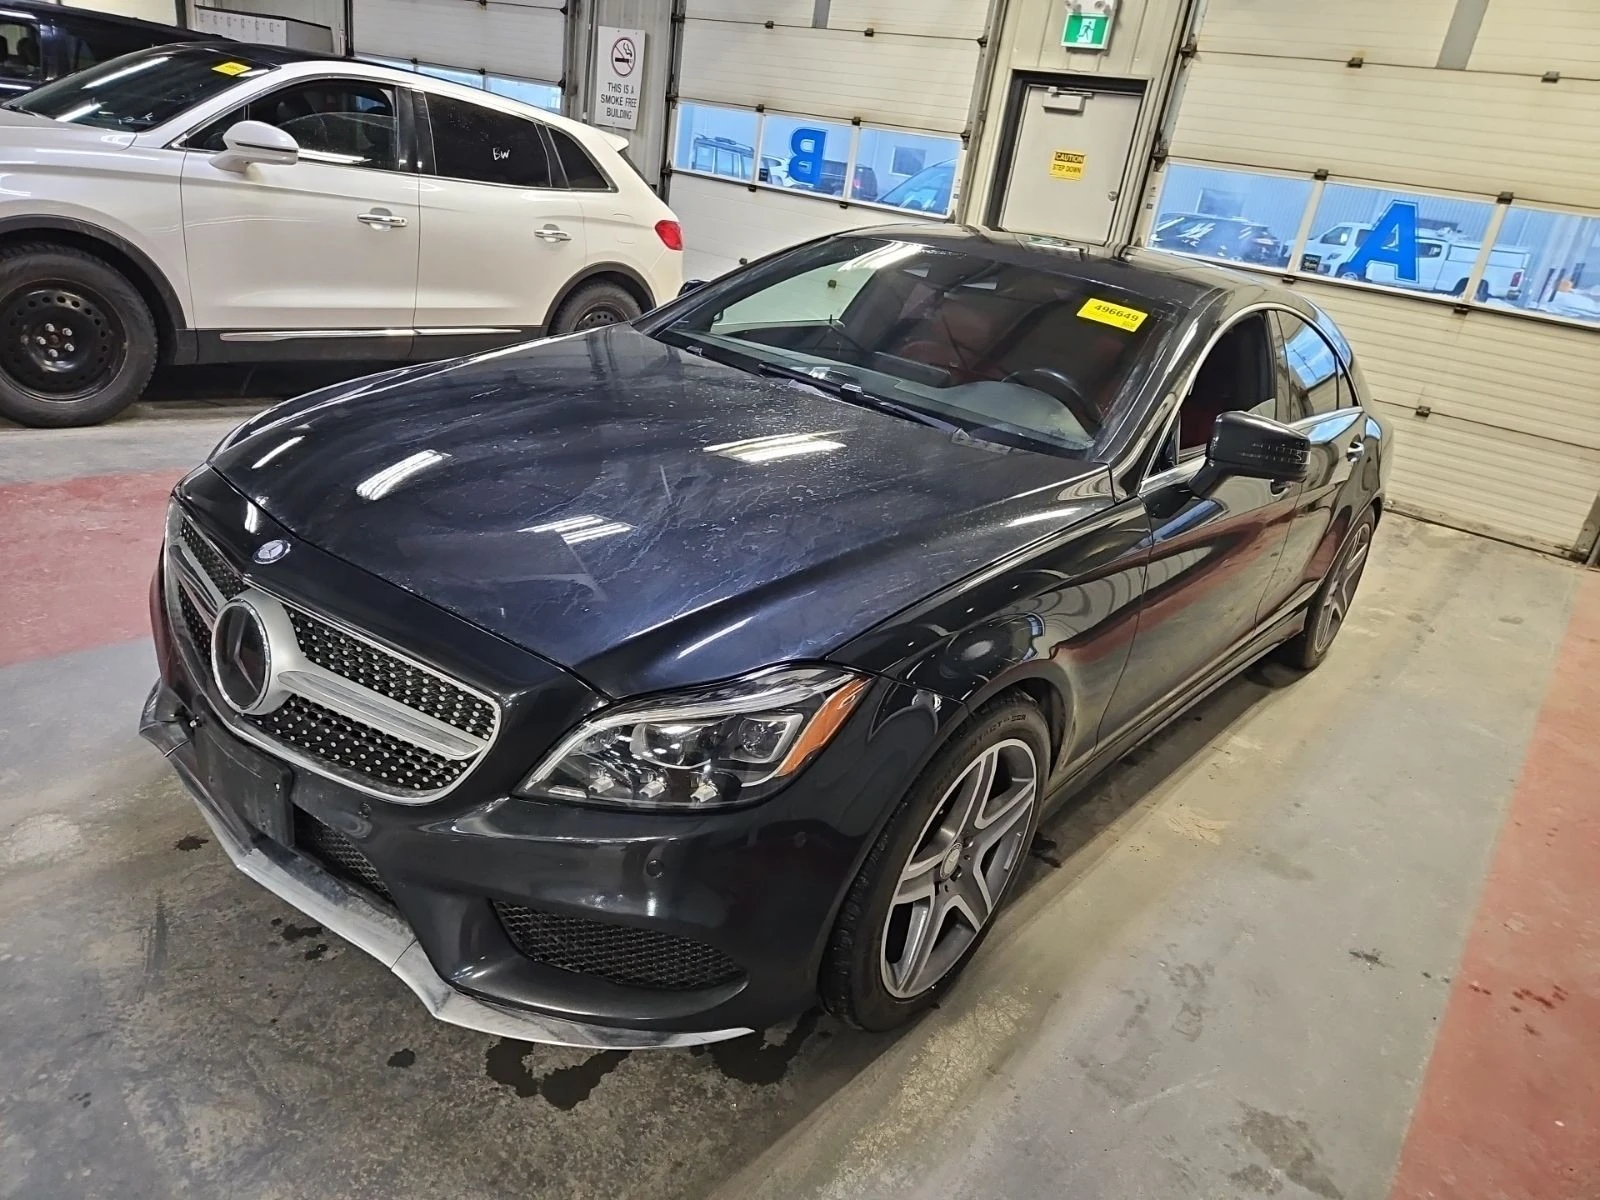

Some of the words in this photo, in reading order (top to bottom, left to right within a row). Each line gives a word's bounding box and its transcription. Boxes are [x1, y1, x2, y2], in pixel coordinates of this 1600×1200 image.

[608, 82, 622, 93] THIS
[624, 84, 629, 94] IS
[630, 86, 635, 95] A
[600, 94, 623, 106] SMOKE
[625, 97, 637, 108] FREE
[606, 107, 632, 120] BUILDING
[1055, 153, 1084, 163] CAUTION
[1339, 200, 1419, 283] A
[1094, 304, 1139, 322] 496649
